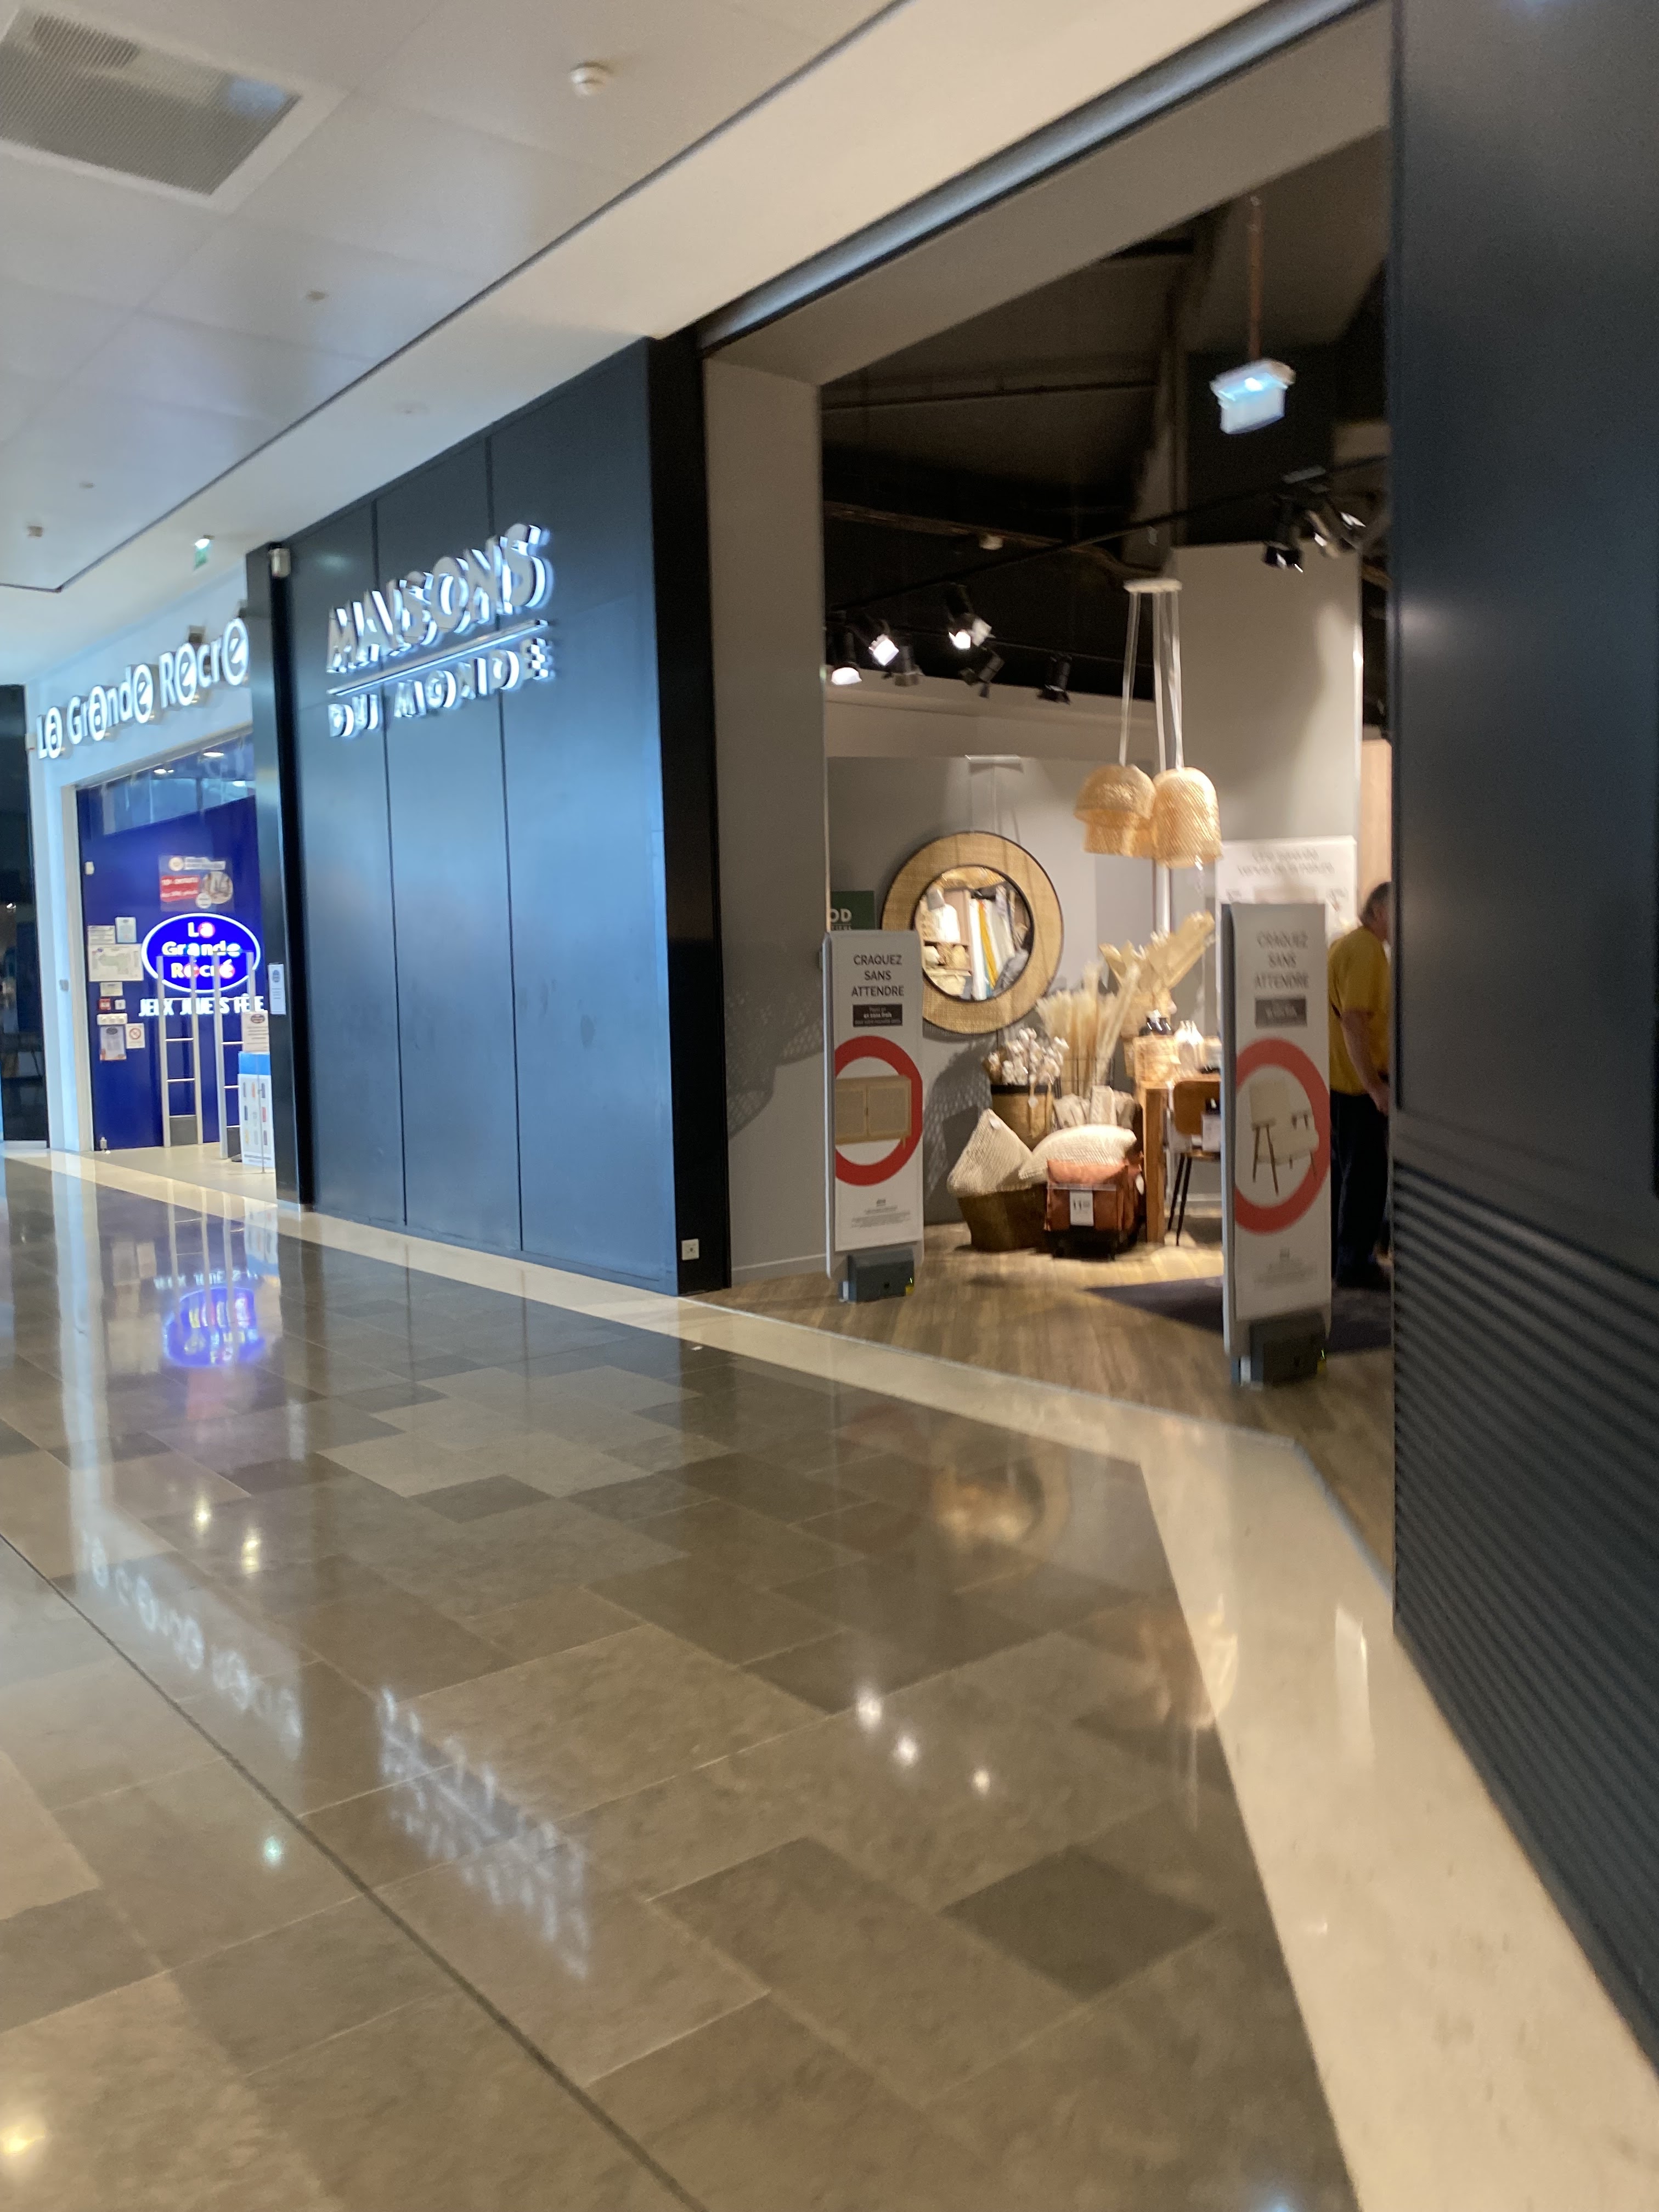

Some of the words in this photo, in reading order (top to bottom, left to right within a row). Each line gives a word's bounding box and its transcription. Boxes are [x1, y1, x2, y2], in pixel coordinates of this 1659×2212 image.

[36, 707, 63, 759] La
[67, 664, 154, 744] Grande
[328, 693, 380, 737] DU
[188, 922, 215, 938] La
[162, 940, 241, 957] Grande
[853, 954, 902, 966] CRAQUEZ
[864, 970, 891, 981] SANS
[851, 986, 904, 996] ATTENDRE
[179, 996, 230, 1015] JOUES
[233, 993, 264, 1013] FÊE
